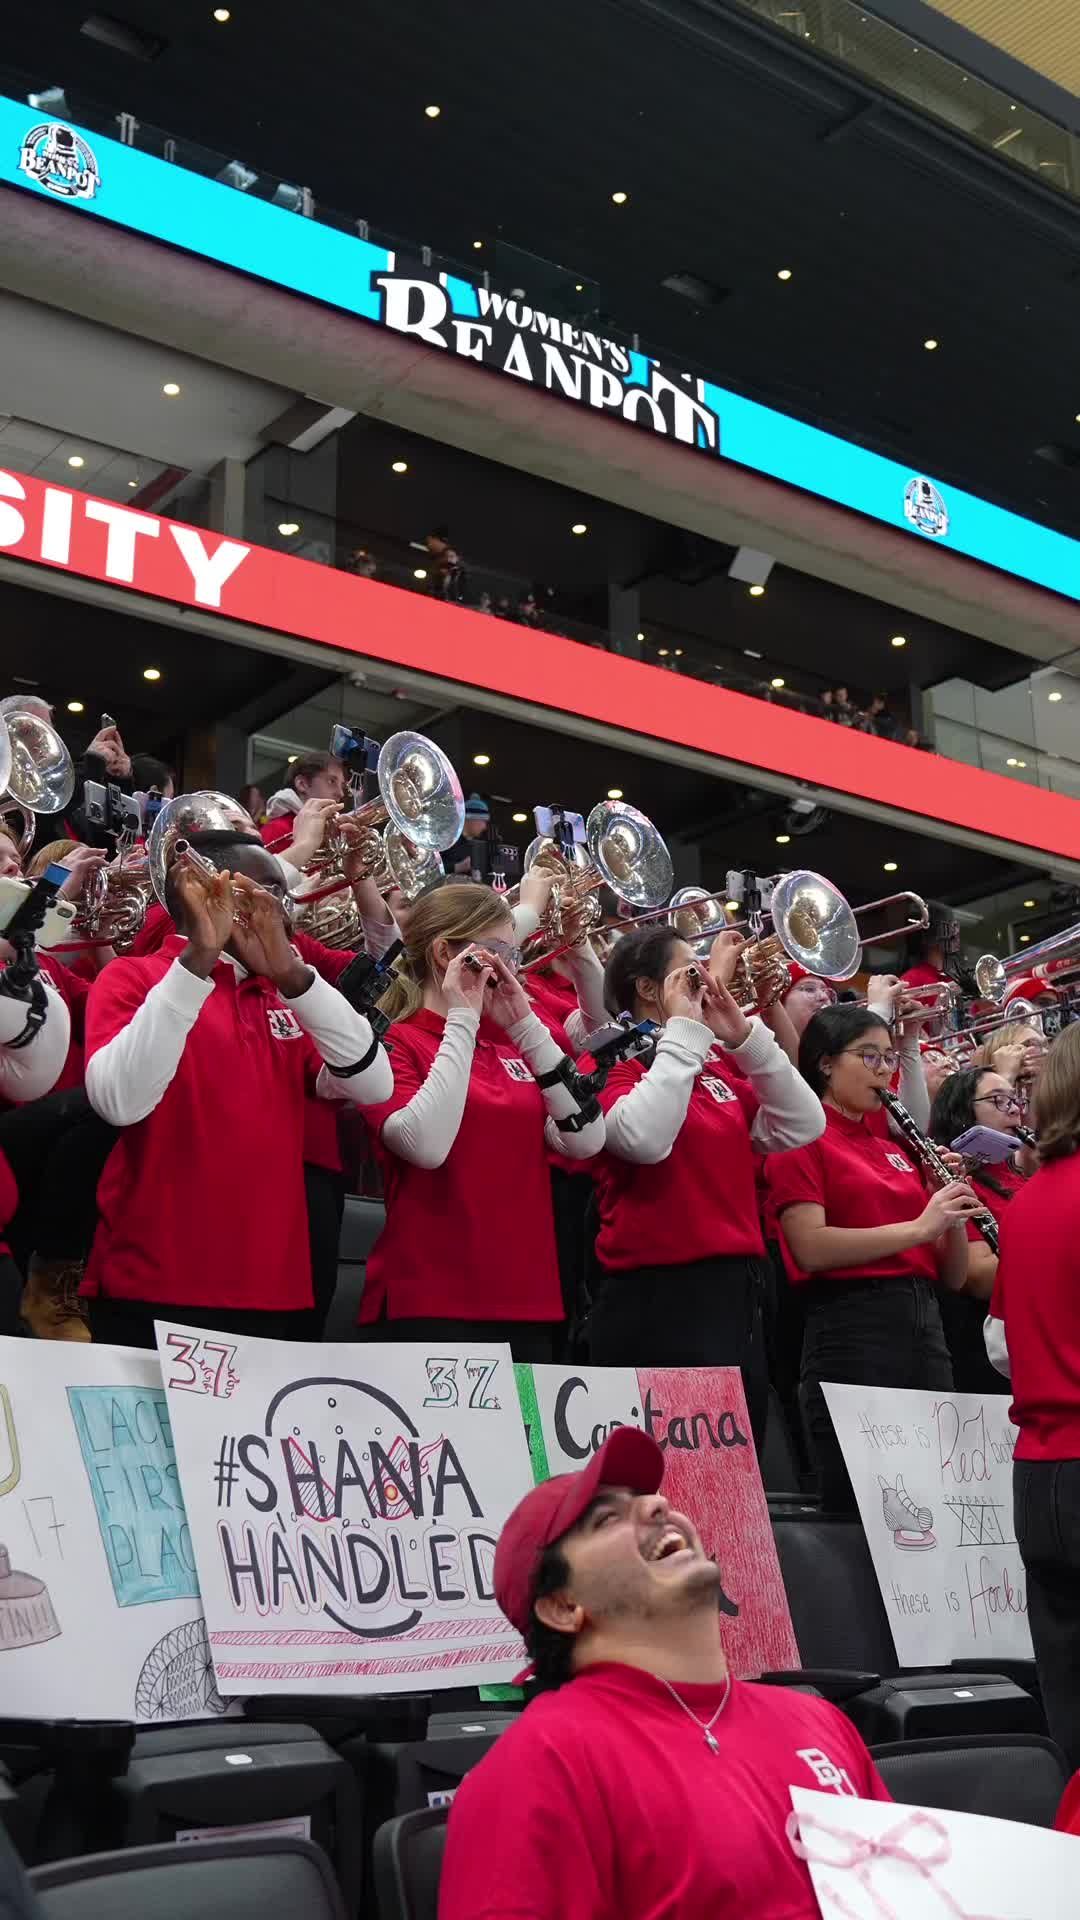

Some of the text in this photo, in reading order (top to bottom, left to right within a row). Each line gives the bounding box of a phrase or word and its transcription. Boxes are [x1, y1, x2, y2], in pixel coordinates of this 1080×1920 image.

[18, 147, 101, 198] BEANPOT
[478, 287, 630, 374] WOMEN'S
[166, 1333, 240, 1399] 37
[423, 1358, 501, 1410] 37
[80, 1396, 174, 1452] LACE
[554, 1376, 748, 1460] Catana
[913, 1423, 931, 1449] is
[932, 1401, 992, 1485] Red
[214, 1433, 484, 1519] #SHANA
[217, 1520, 499, 1614] HANDLED
[892, 1580, 931, 1615] these
[945, 1591, 961, 1613] is
